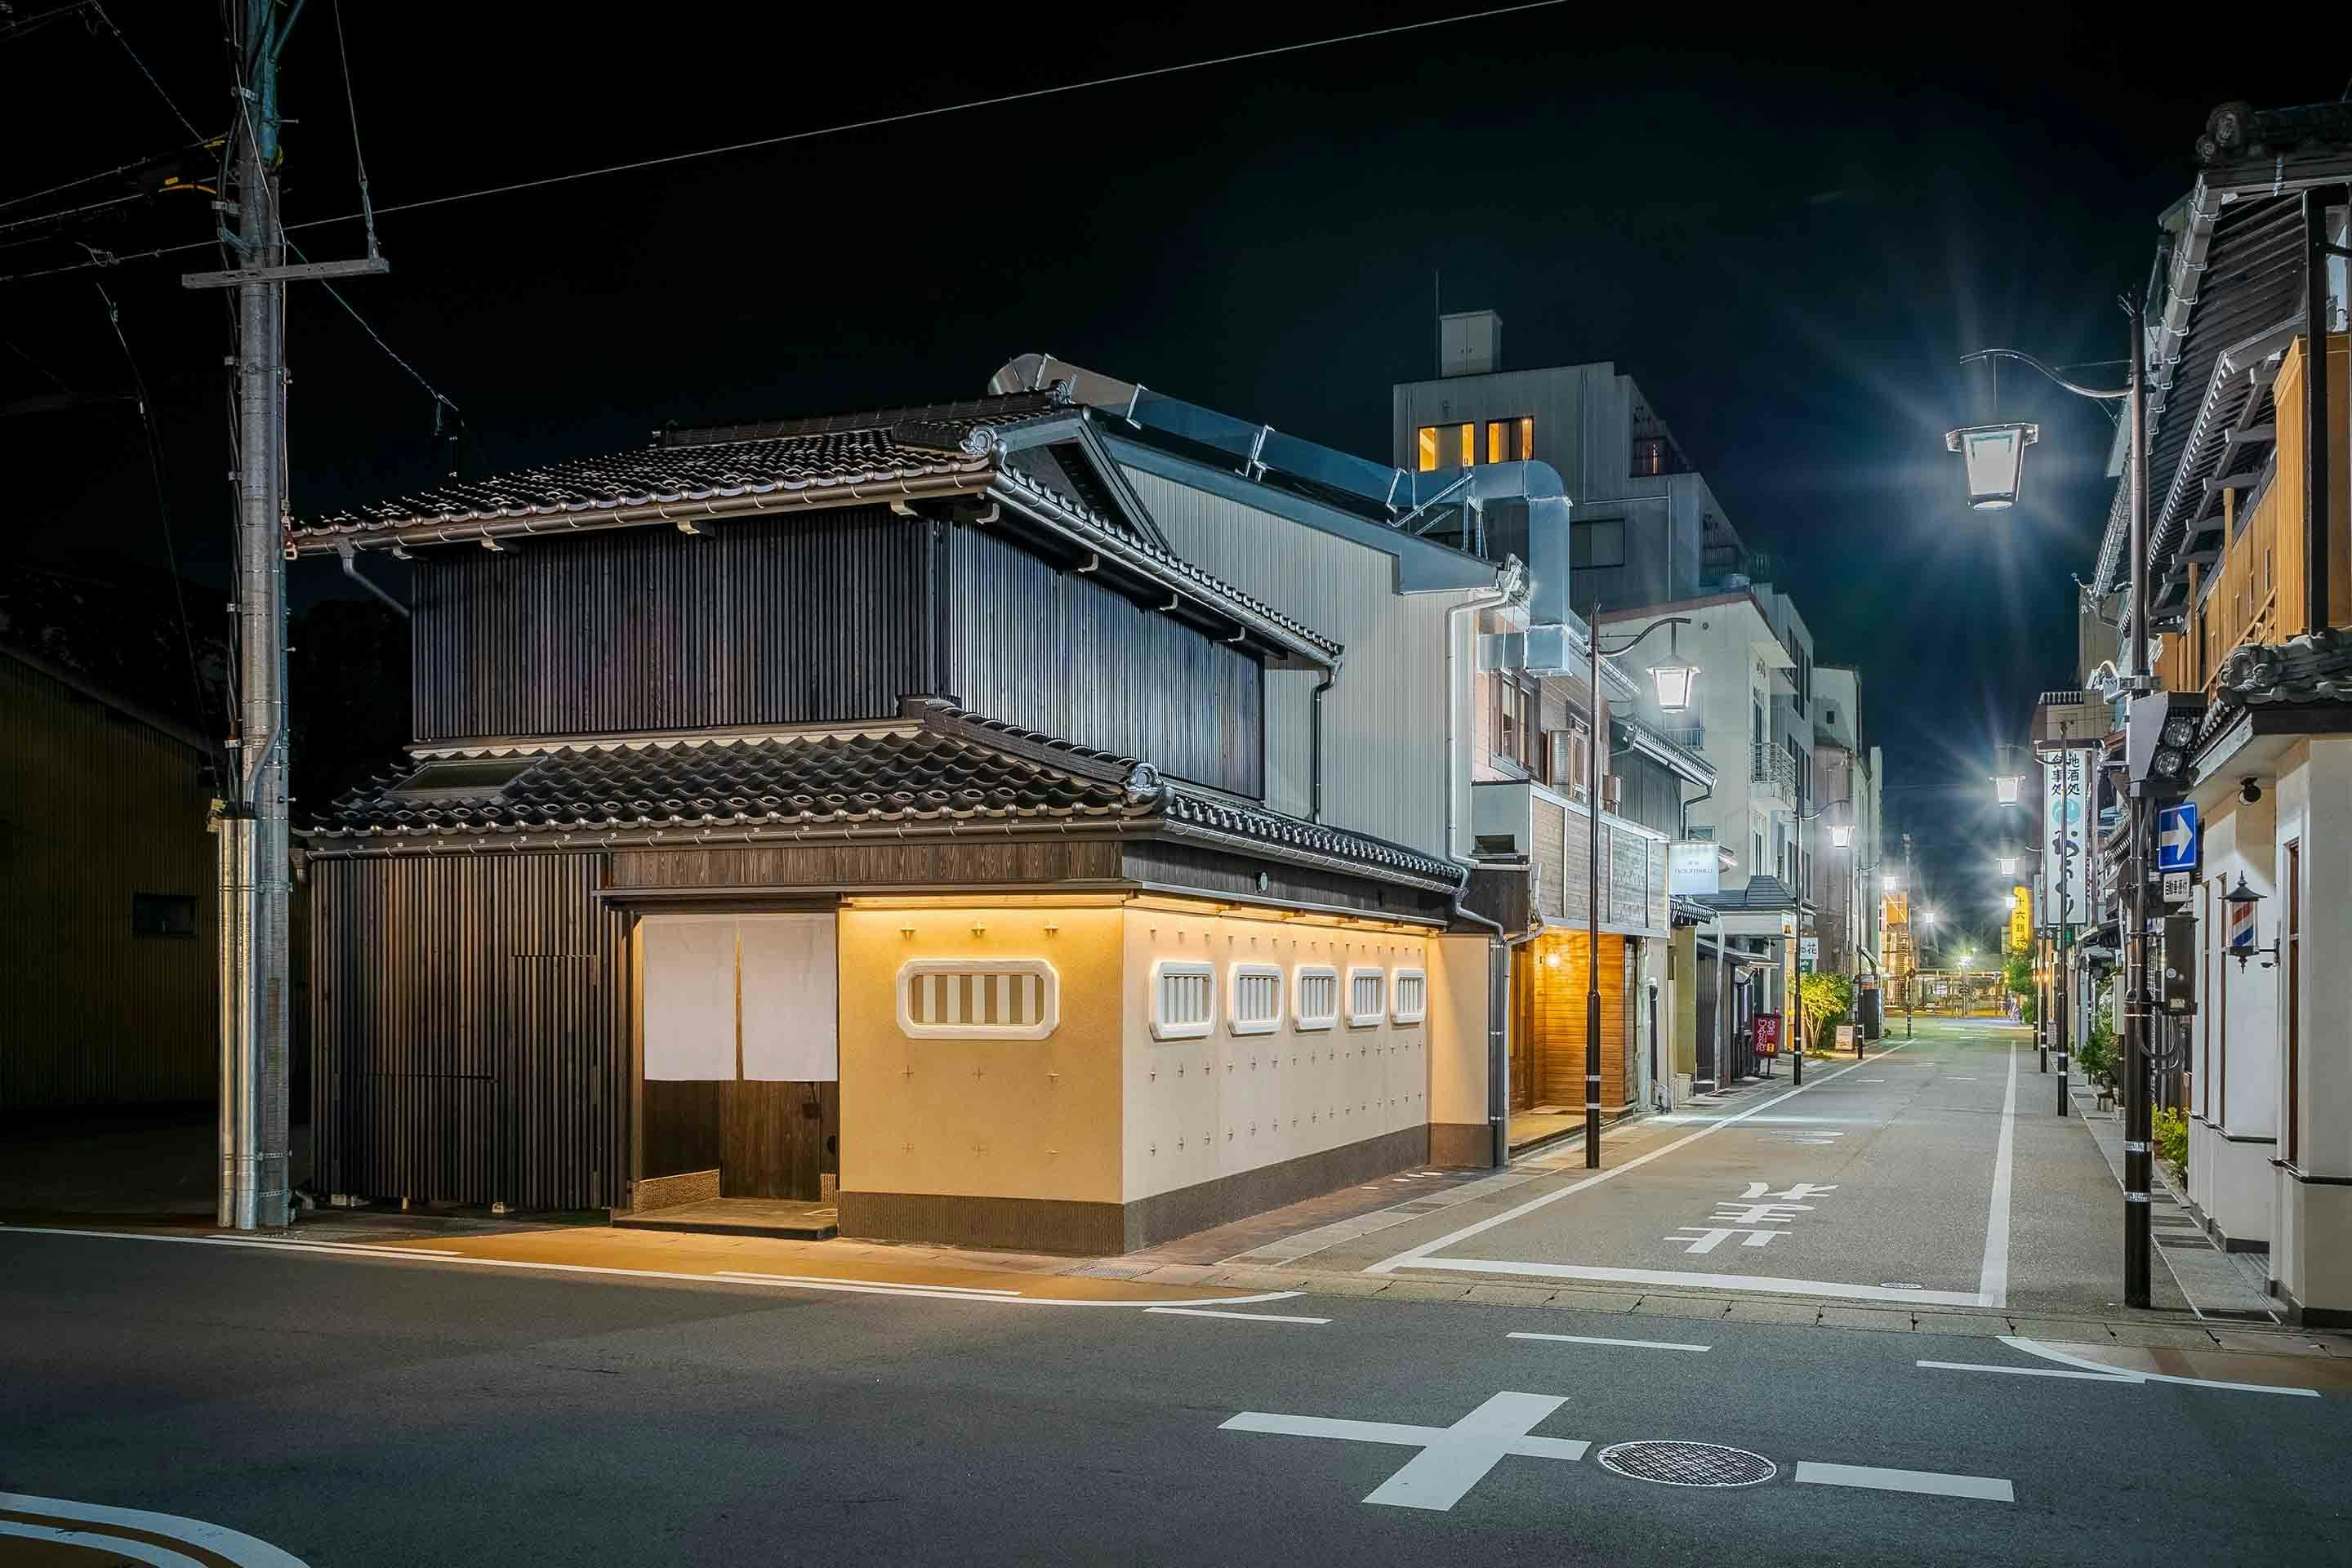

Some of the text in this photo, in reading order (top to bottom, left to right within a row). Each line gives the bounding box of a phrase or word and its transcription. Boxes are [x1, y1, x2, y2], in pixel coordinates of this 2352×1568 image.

[2065, 751, 2080, 796] 地酒処
[1664, 1182, 1839, 1254] 止まれ
